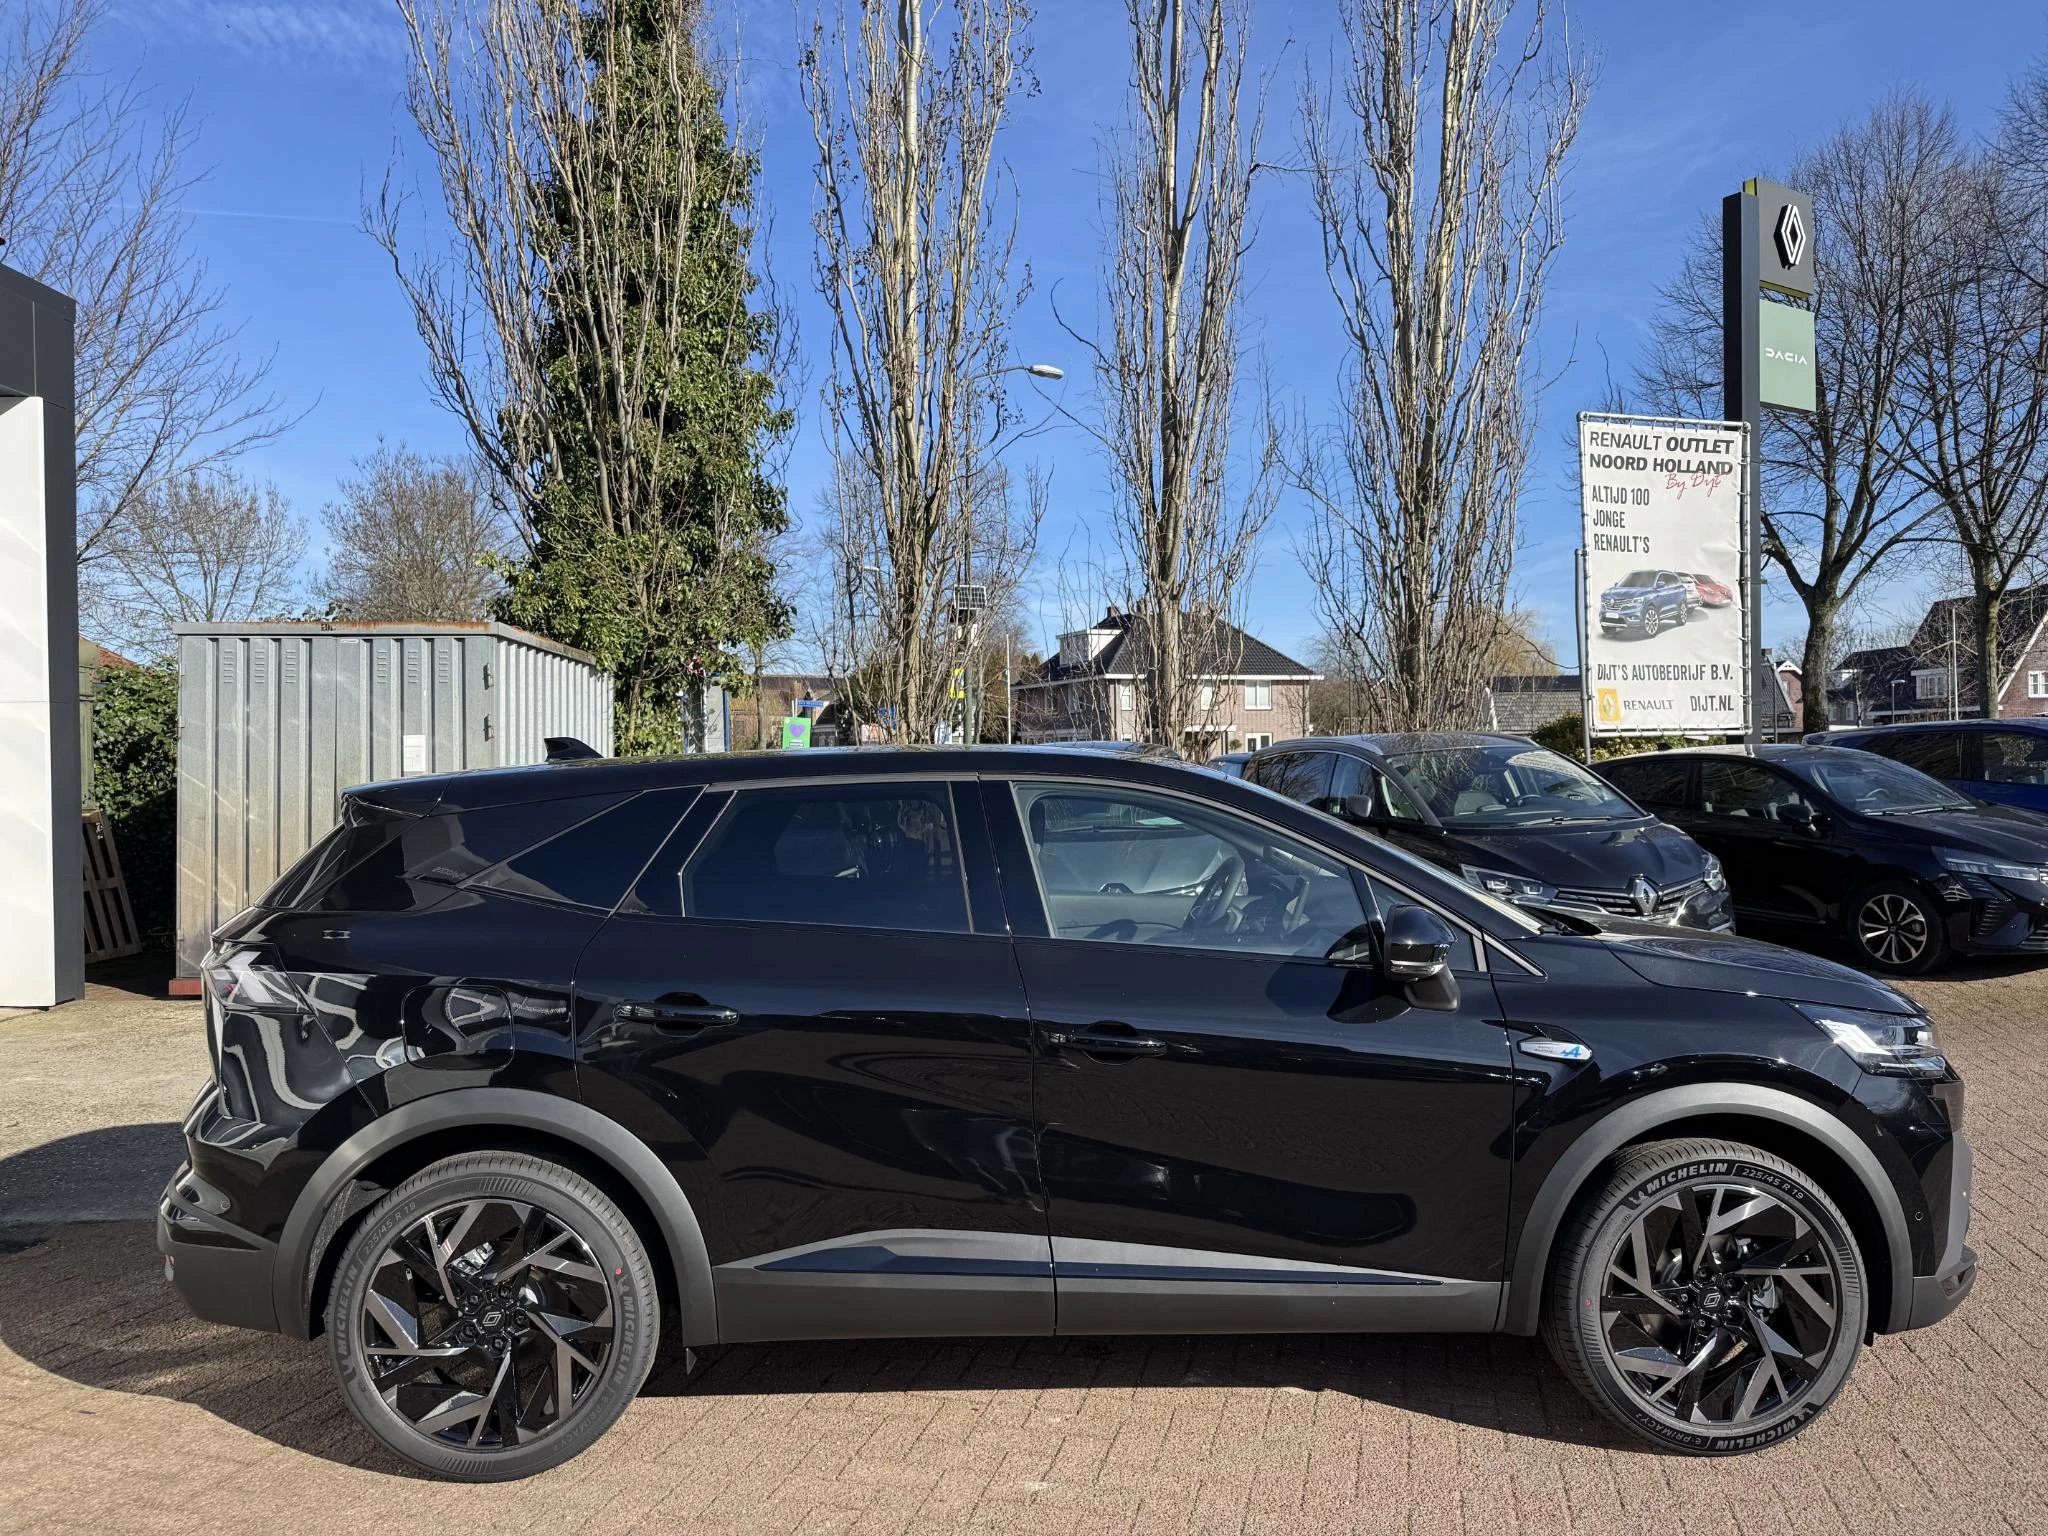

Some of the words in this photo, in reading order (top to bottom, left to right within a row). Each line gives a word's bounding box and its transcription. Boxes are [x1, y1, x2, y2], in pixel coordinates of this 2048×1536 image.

[1765, 347, 1807, 366] DACIA
[1590, 431, 1662, 450] RENAULT
[1666, 436, 1734, 454] OUTLET
[1590, 453, 1647, 471] NOORD
[1653, 458, 1733, 475] HOLLAND
[1592, 485, 1627, 505] ALTIJD
[1631, 488, 1650, 506] 100
[1664, 473, 1687, 500] By
[1593, 509, 1625, 528] JONGE
[1594, 534, 1650, 553] RENAULT'S
[1597, 664, 1628, 681] DIJT'S
[1632, 664, 1706, 681] AUTOBEDRIJF
[1711, 664, 1733, 681] B.V.
[1623, 699, 1674, 711] RENAULT
[1690, 695, 1734, 712] DIJT.NL
[1647, 1163, 1728, 1194] MICHELIN
[1741, 1168, 1780, 1187] 225/45
[1783, 1182, 1791, 1192] R
[1792, 1188, 1805, 1200] 19
[336, 1264, 359, 1356] MICHELIN
[364, 1217, 393, 1254] 225/45
[613, 1296, 635, 1385] MICHELIN
[1716, 1419, 1797, 1450] MICHELIN
